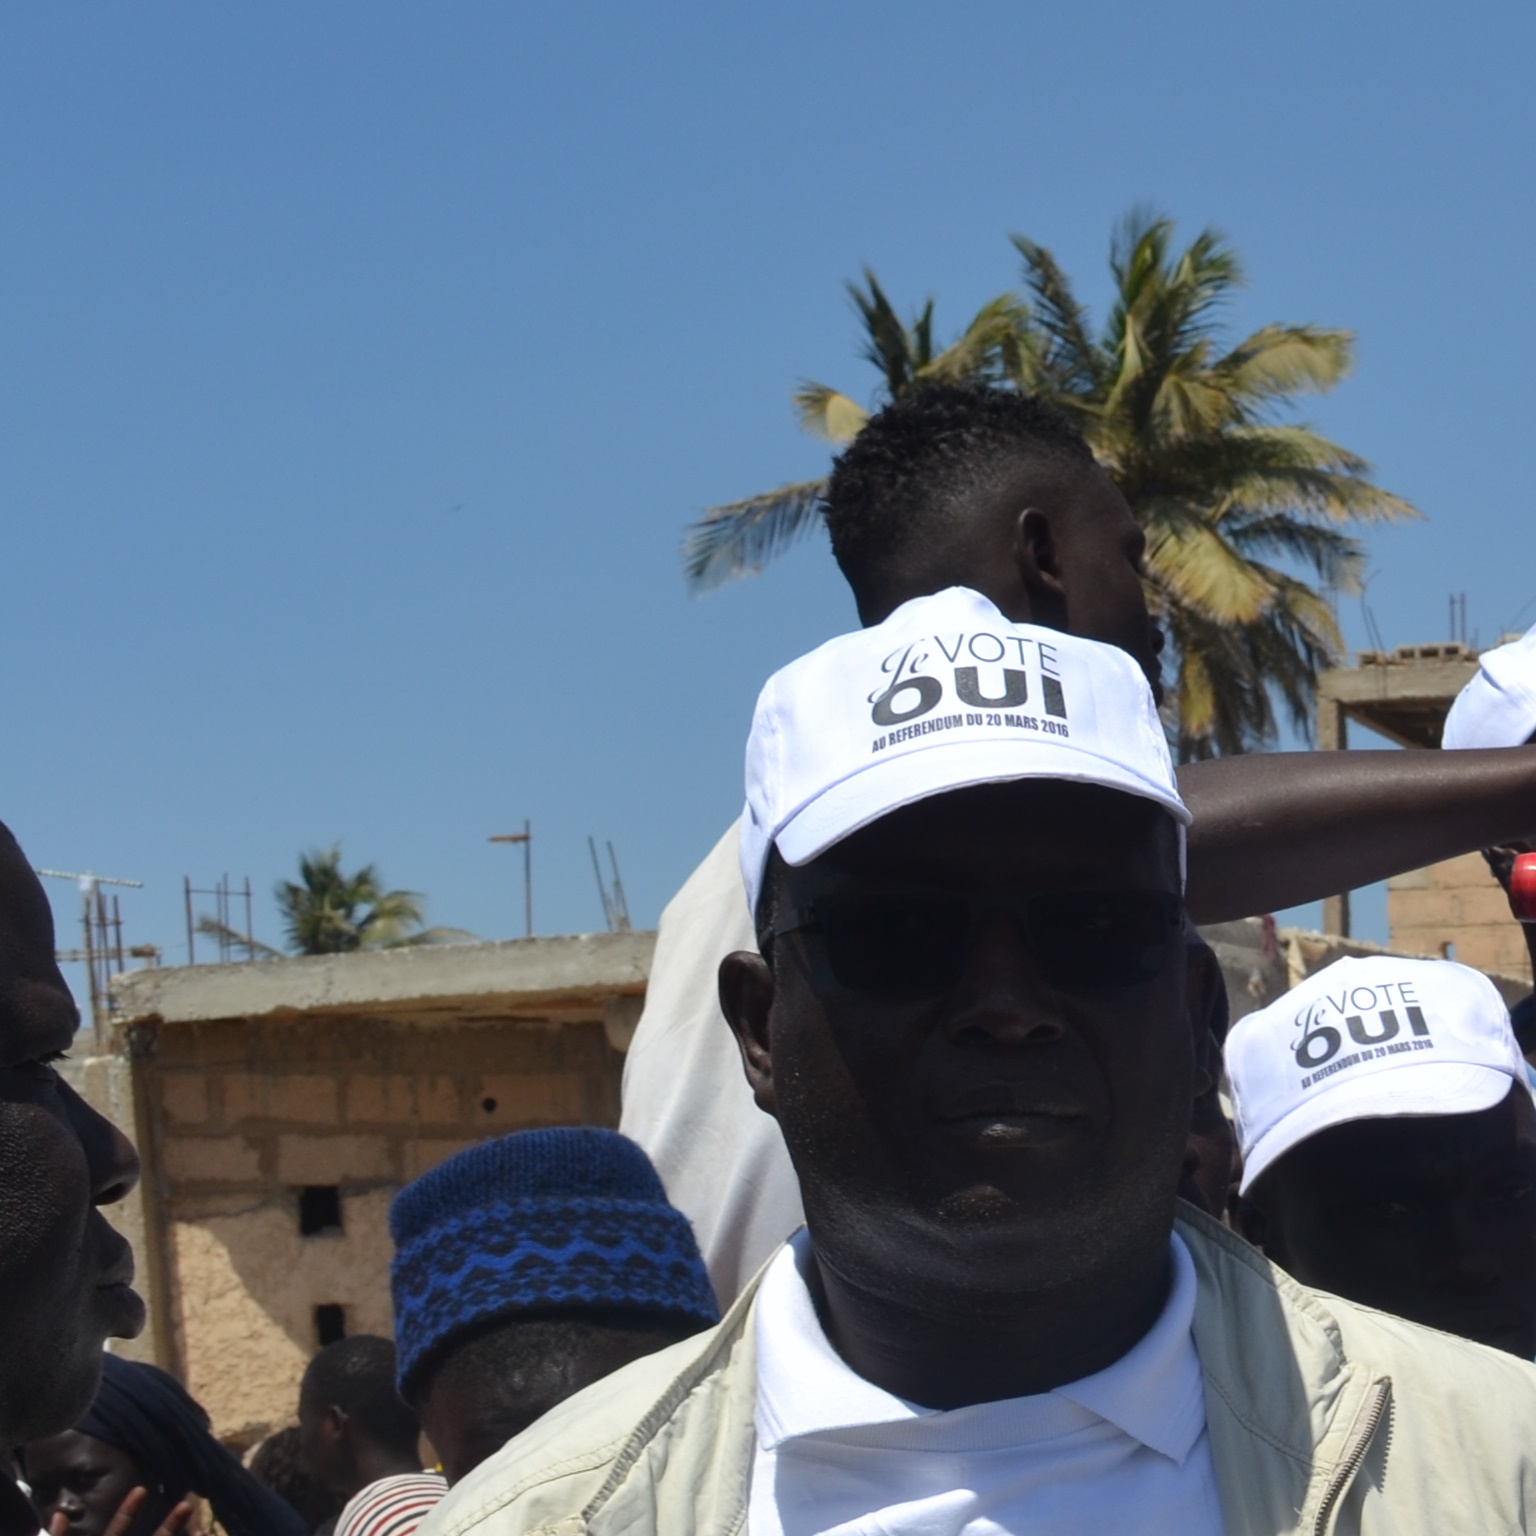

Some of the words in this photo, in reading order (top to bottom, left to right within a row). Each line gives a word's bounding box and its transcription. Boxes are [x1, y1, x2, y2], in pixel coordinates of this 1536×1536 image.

[867, 638, 929, 704] Je
[934, 632, 1060, 677] VOTE
[871, 666, 1067, 727] OUI
[871, 737, 887, 753] AU
[889, 714, 963, 747] REFERENDUM
[966, 713, 983, 726] DU
[986, 713, 1002, 726] 20
[1005, 713, 1039, 731] MARS
[1041, 719, 1070, 738] 2016
[1326, 982, 1419, 1015] VOTE
[1295, 1006, 1430, 1068] OUI
[1301, 1075, 1312, 1090] AU
[1312, 1053, 1361, 1083] REFERENDUM
[1361, 1049, 1374, 1061] DU
[1375, 1046, 1387, 1058] 20
[1386, 1040, 1411, 1055] MARS
[1411, 1039, 1434, 1050] 2016
